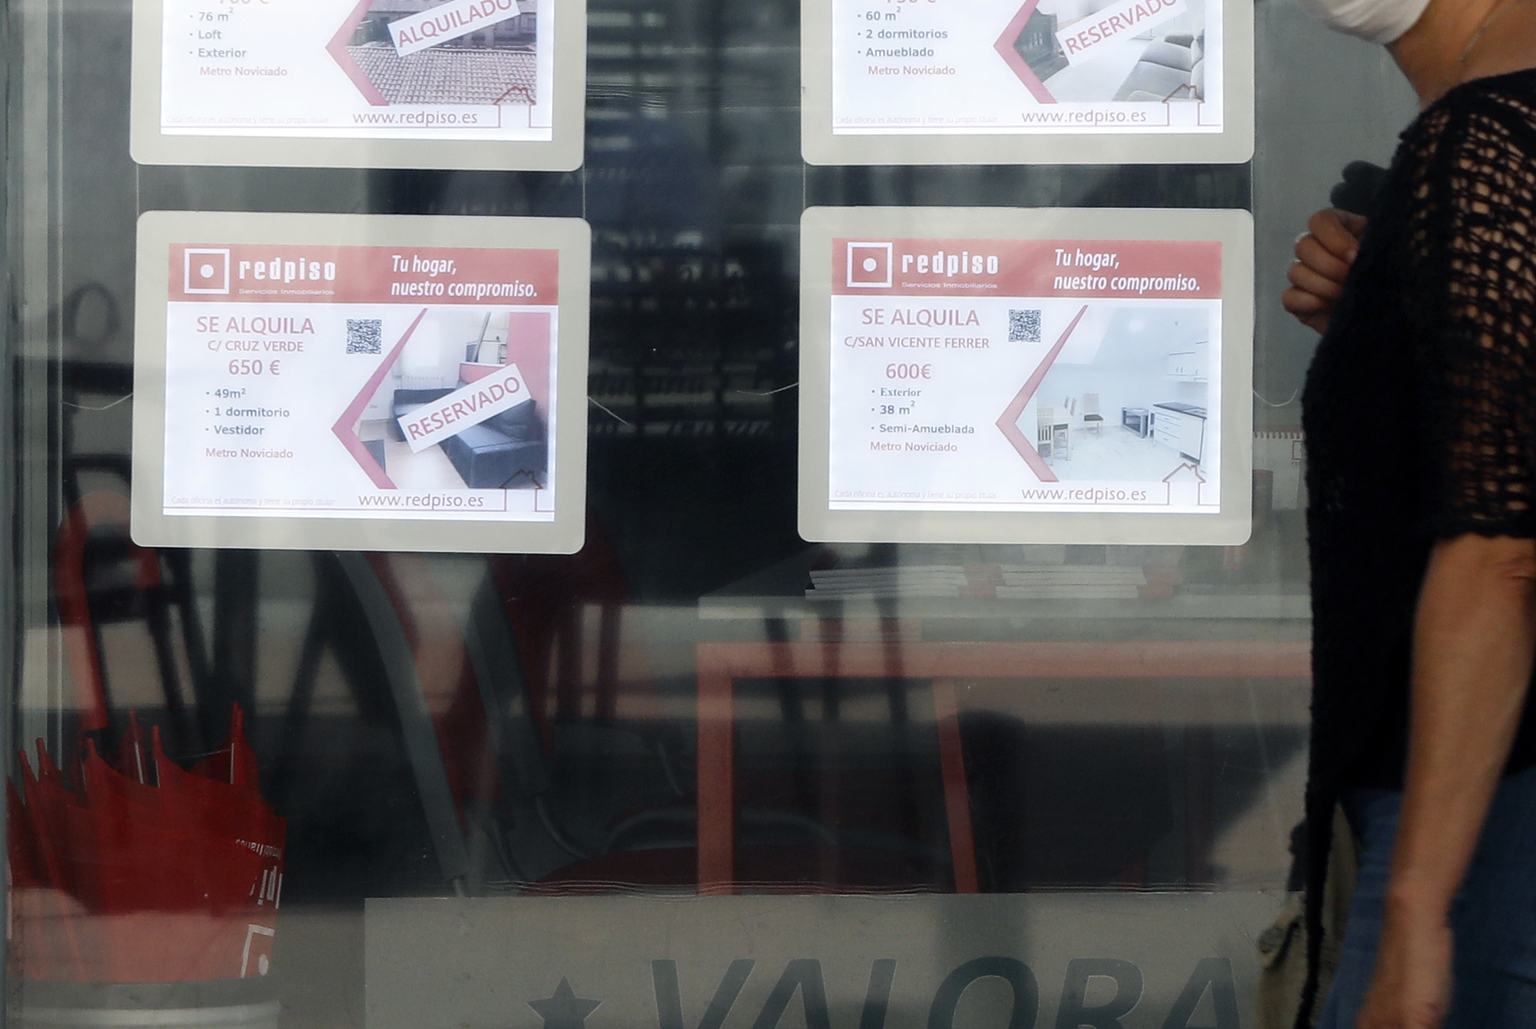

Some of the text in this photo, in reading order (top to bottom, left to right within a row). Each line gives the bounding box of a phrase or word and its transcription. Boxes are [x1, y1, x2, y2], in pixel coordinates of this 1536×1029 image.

[239, 257, 336, 283] redpiso
[392, 255, 456, 275] Tu hogar,
[902, 251, 998, 277] redpiso
[392, 281, 537, 299] nuestro compromiso.
[197, 316, 314, 335] SE ALQUILA
[862, 309, 979, 328] SE ALQUILA
[208, 340, 303, 353] C/ CRUZ VERDE
[845, 337, 884, 349] C/SAN
[889, 337, 940, 348] VICENTE
[229, 360, 280, 375] 650 €
[886, 363, 931, 379] 600€
[409, 376, 520, 440] RESERVADO
[359, 493, 483, 508] www.redpiso.es
[1021, 487, 1146, 502] www.redpiso.es
